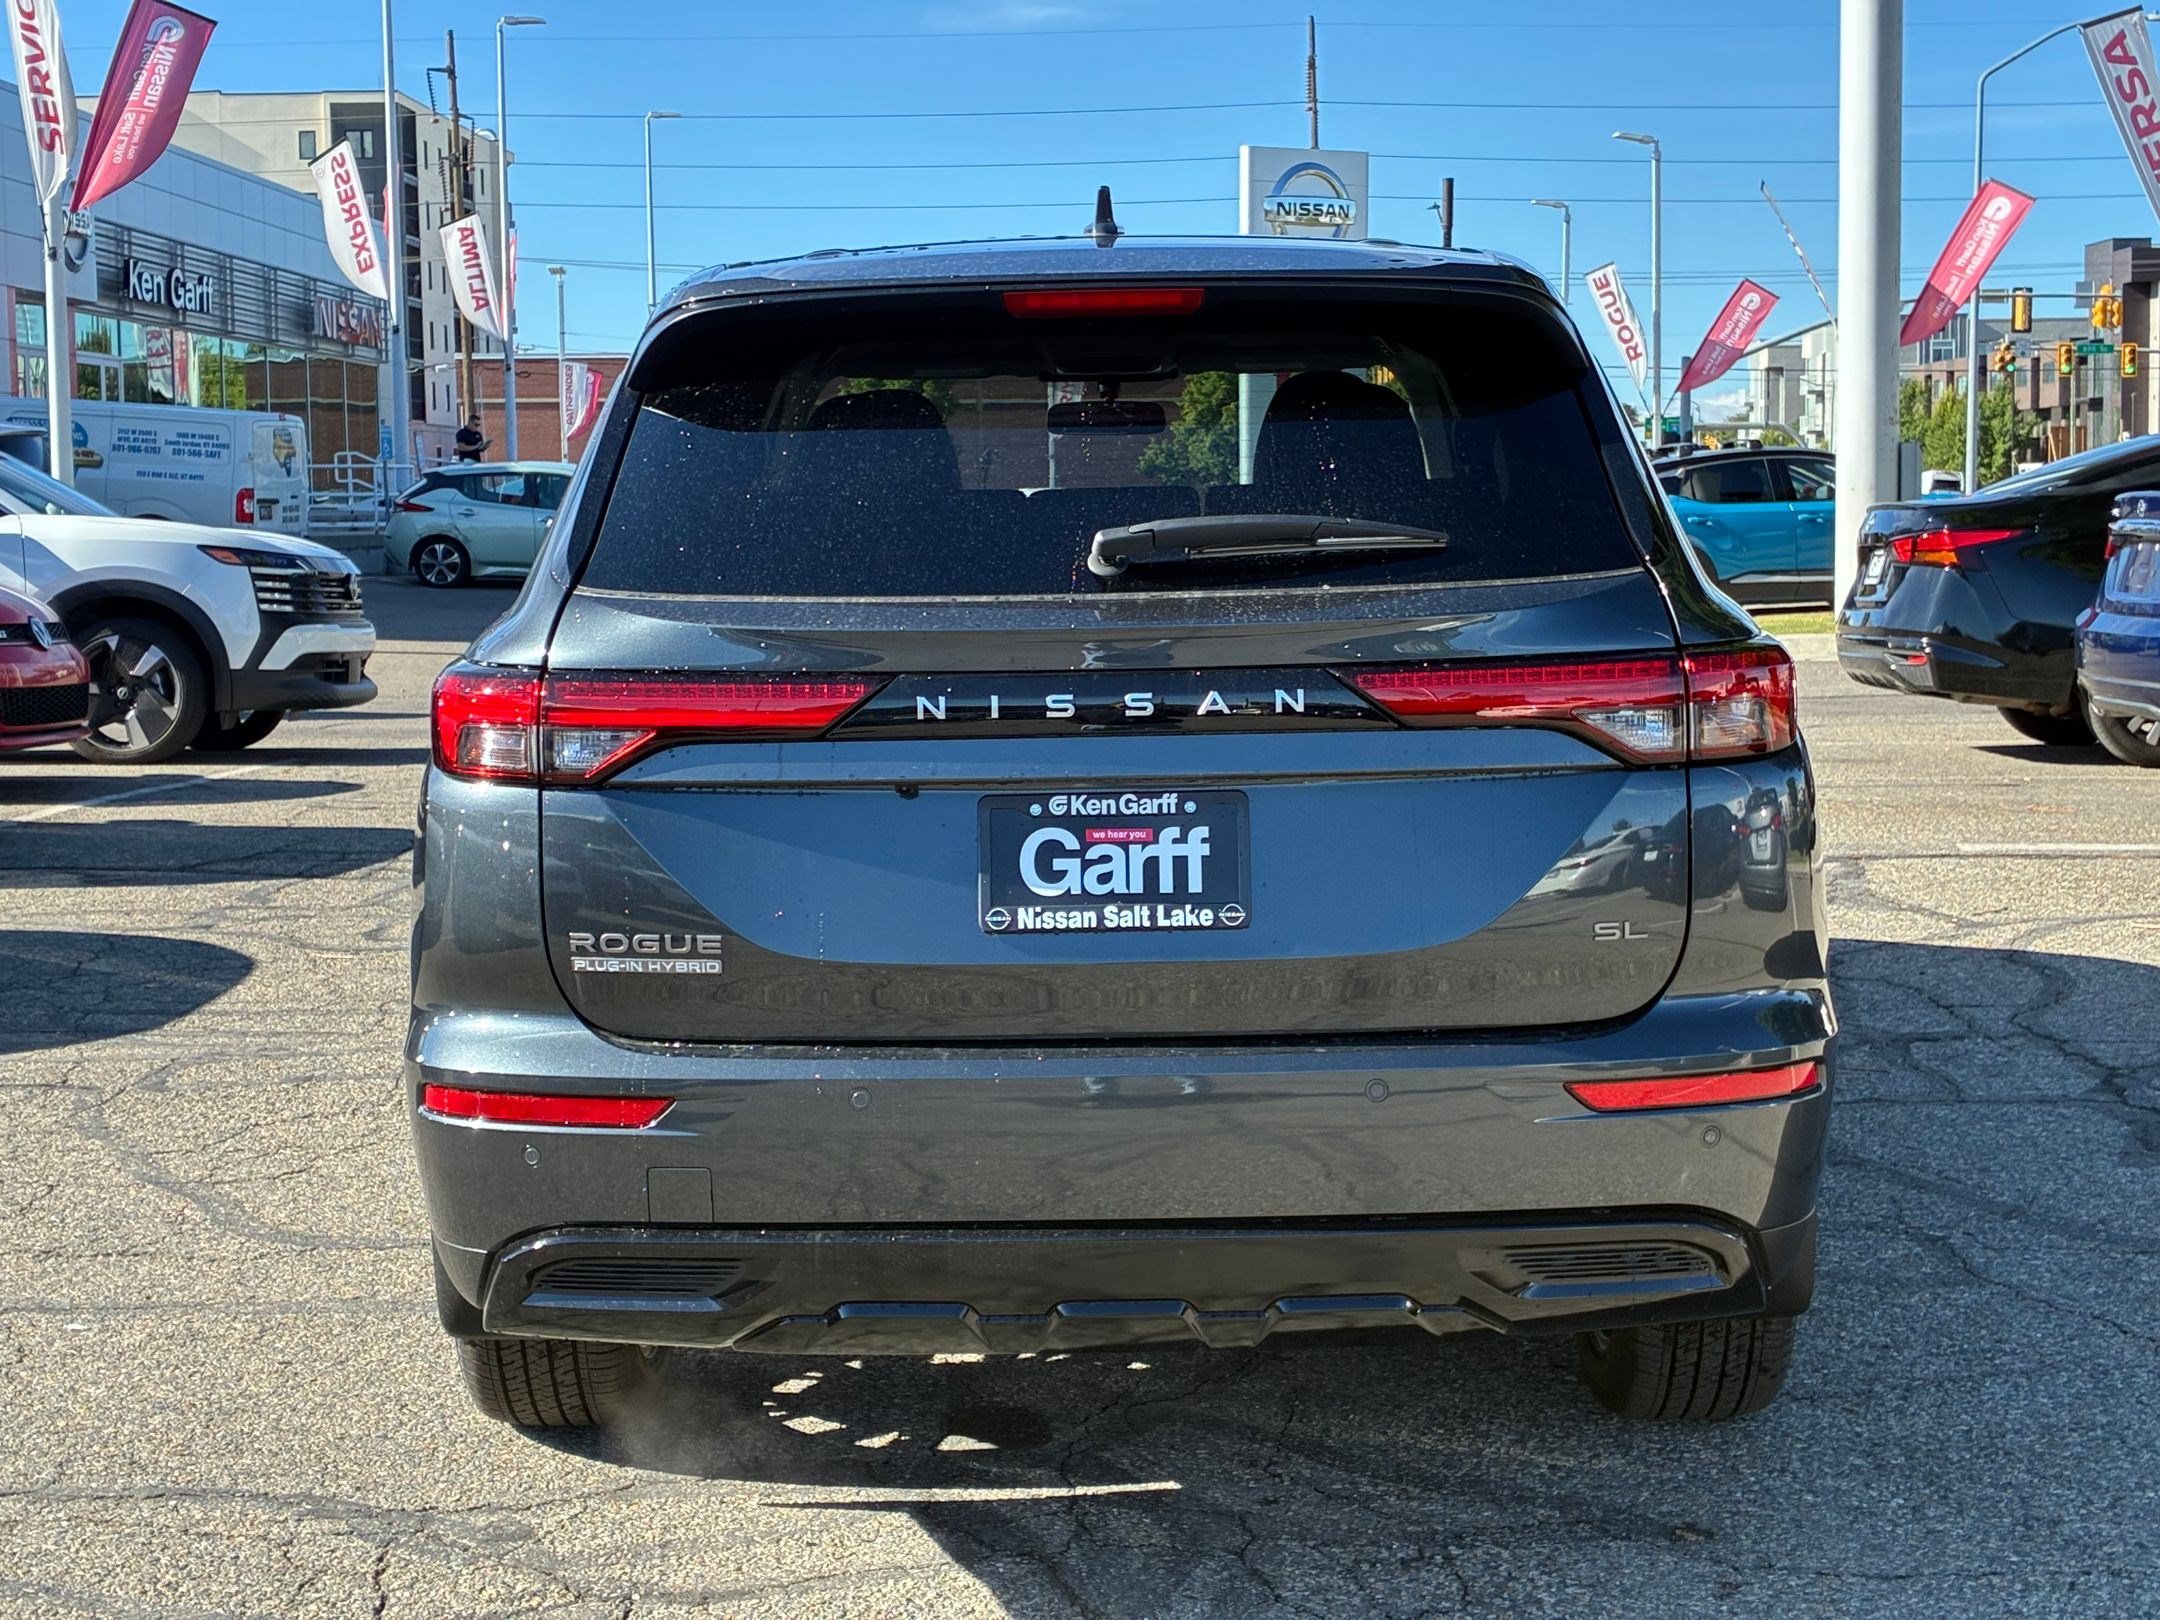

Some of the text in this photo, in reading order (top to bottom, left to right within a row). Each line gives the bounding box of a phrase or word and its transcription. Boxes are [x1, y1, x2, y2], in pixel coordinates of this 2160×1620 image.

[2103, 28, 2160, 184] ERSA
[1276, 201, 1350, 219] NISSAN
[129, 259, 213, 313] Ken Garff
[315, 298, 383, 349] NISSAN
[1592, 273, 1643, 362] ROGUE
[916, 688, 1306, 720] NISSAN
[1071, 793, 1178, 816] Ken Garff
[1092, 830, 1146, 840] we hear you
[1019, 826, 1210, 897] Garff
[1017, 904, 1213, 930] Nissan Salt Lake
[569, 932, 723, 954] ROGUE
[1593, 921, 1648, 941] SL
[573, 960, 720, 973] PLUG-IN HYBRID
